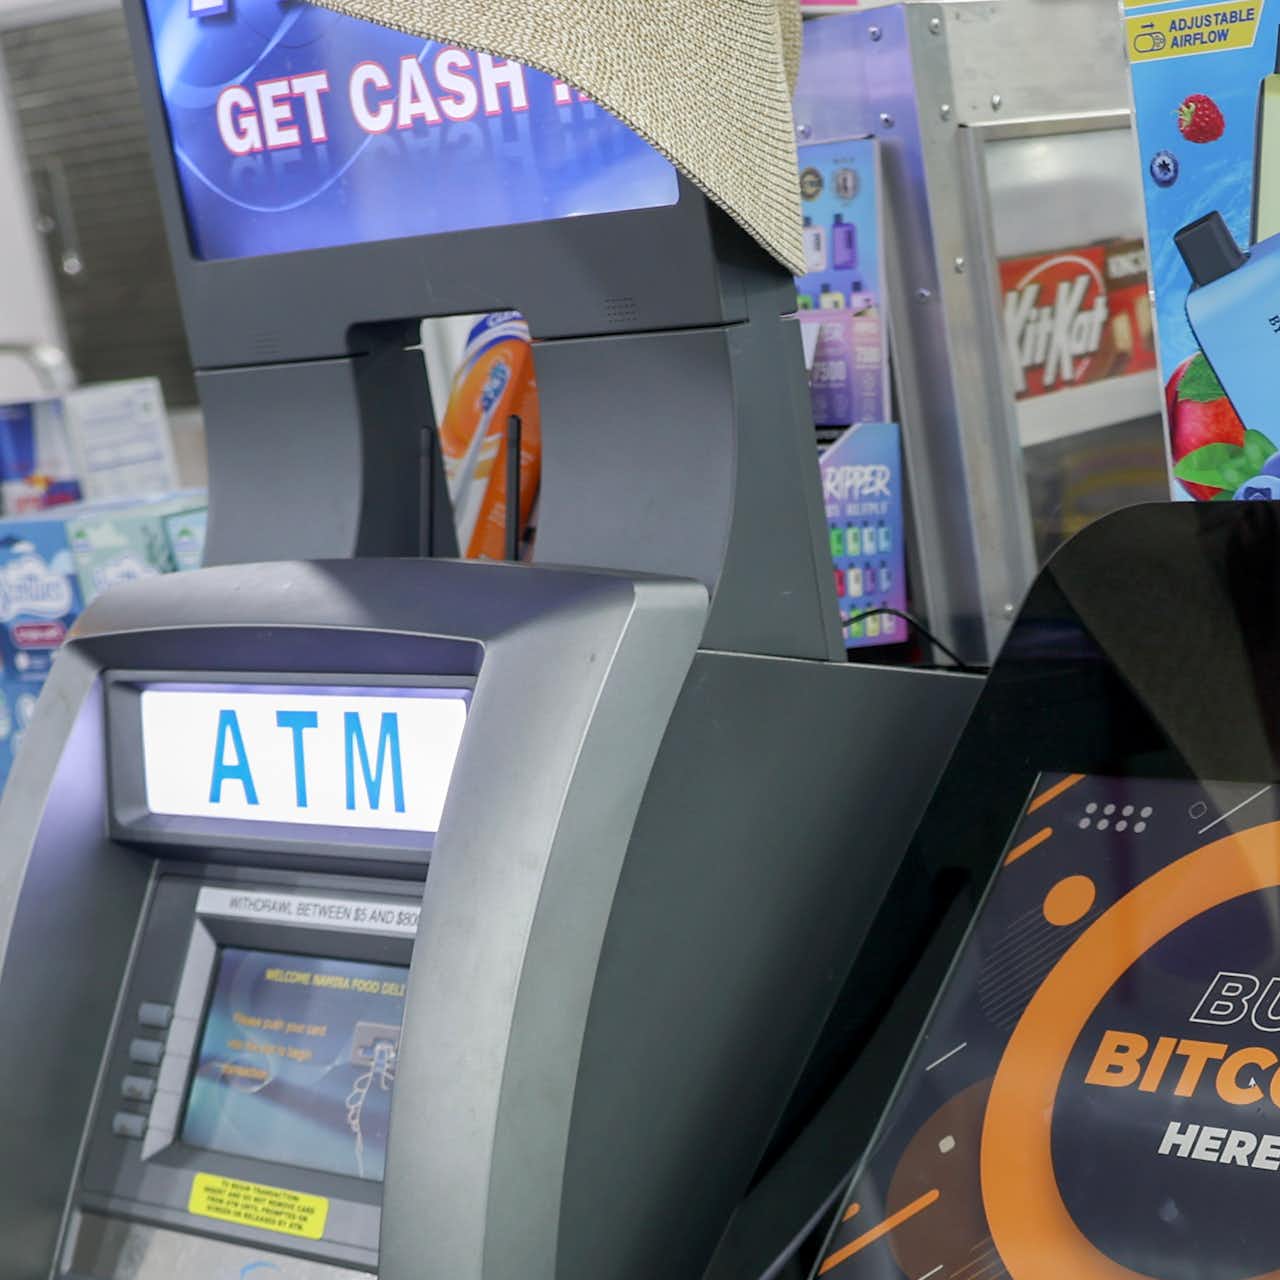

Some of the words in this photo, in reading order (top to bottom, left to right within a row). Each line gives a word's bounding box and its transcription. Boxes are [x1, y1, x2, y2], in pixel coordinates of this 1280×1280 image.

[1169, 8, 1255, 32] ADJUSTABLE
[1171, 29, 1229, 48] AIRFLOW
[217, 71, 329, 156] GET
[350, 48, 529, 135] CASH
[826, 465, 890, 501] RIPPER
[208, 710, 406, 814] ATM
[297, 903, 350, 919] BETWEEN
[370, 910, 393, 924] AND
